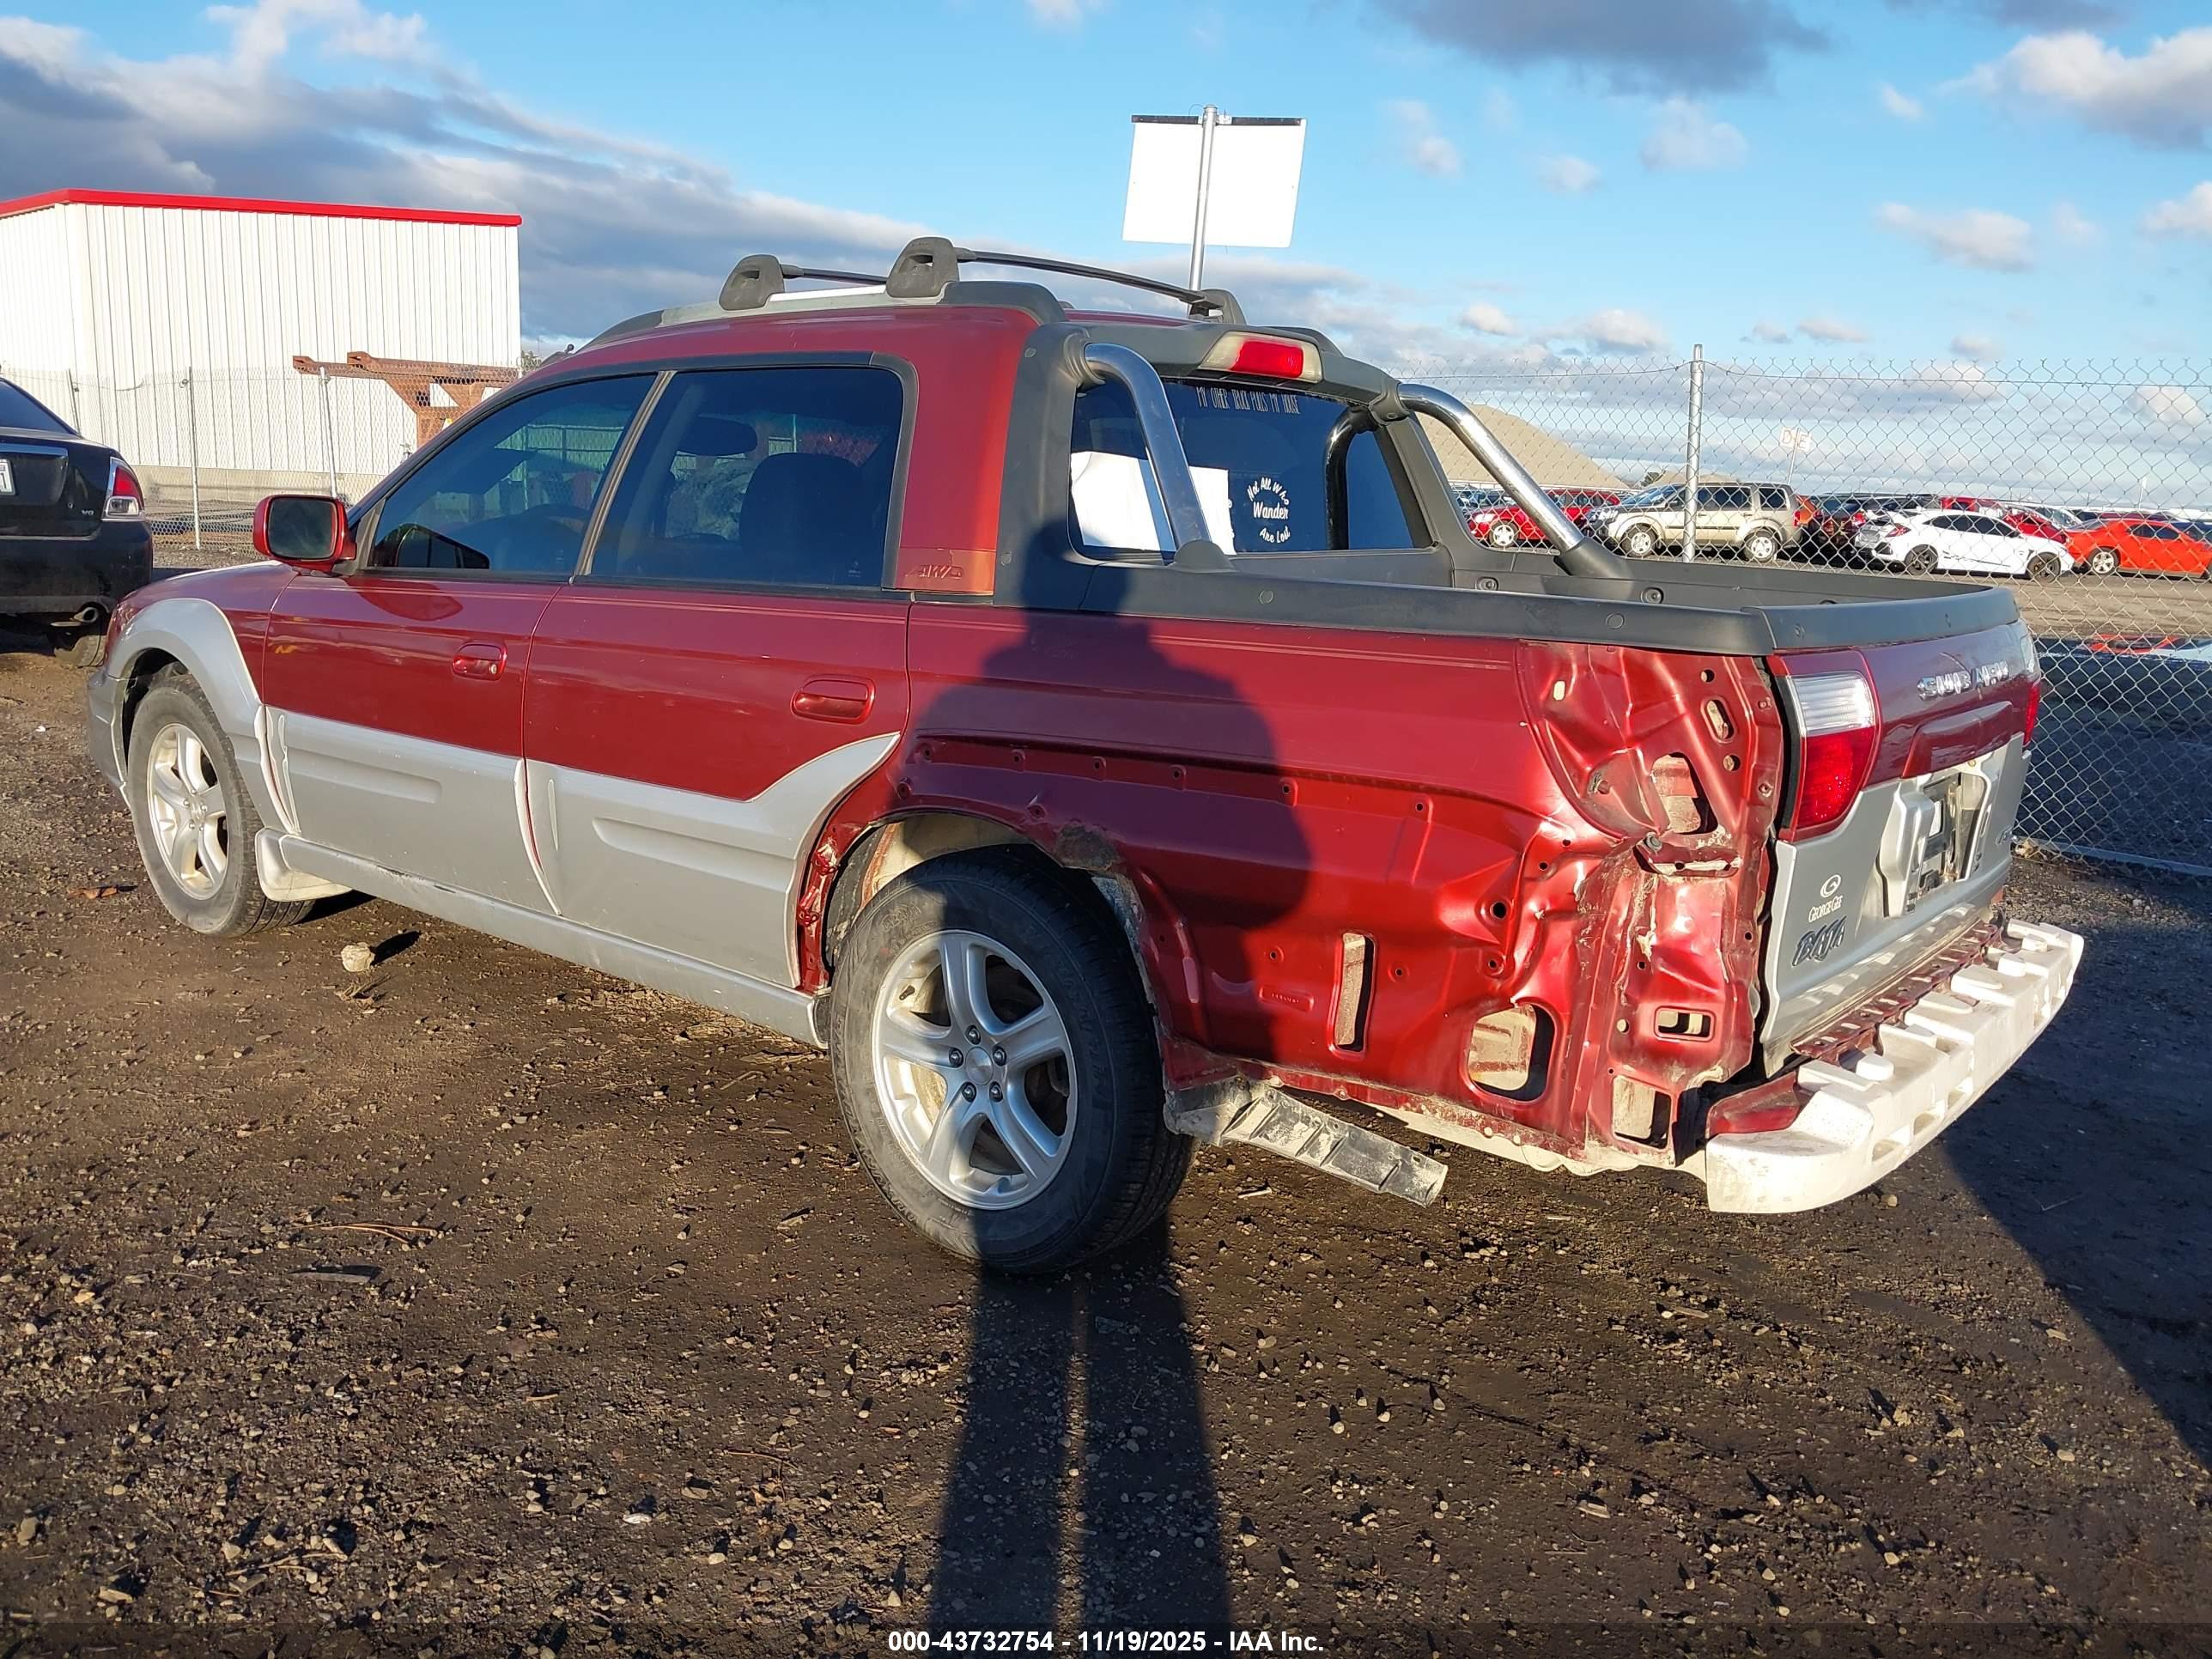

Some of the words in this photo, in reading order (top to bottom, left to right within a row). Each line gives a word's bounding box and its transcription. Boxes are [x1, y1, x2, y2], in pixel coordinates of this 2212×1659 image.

[1261, 477, 1272, 490] All
[1273, 481, 1290, 505] Who
[1253, 501, 1289, 520] Wander
[1260, 527, 1275, 544] Are
[1276, 525, 1291, 544] Lost
[1791, 915, 1848, 967] BAJA
